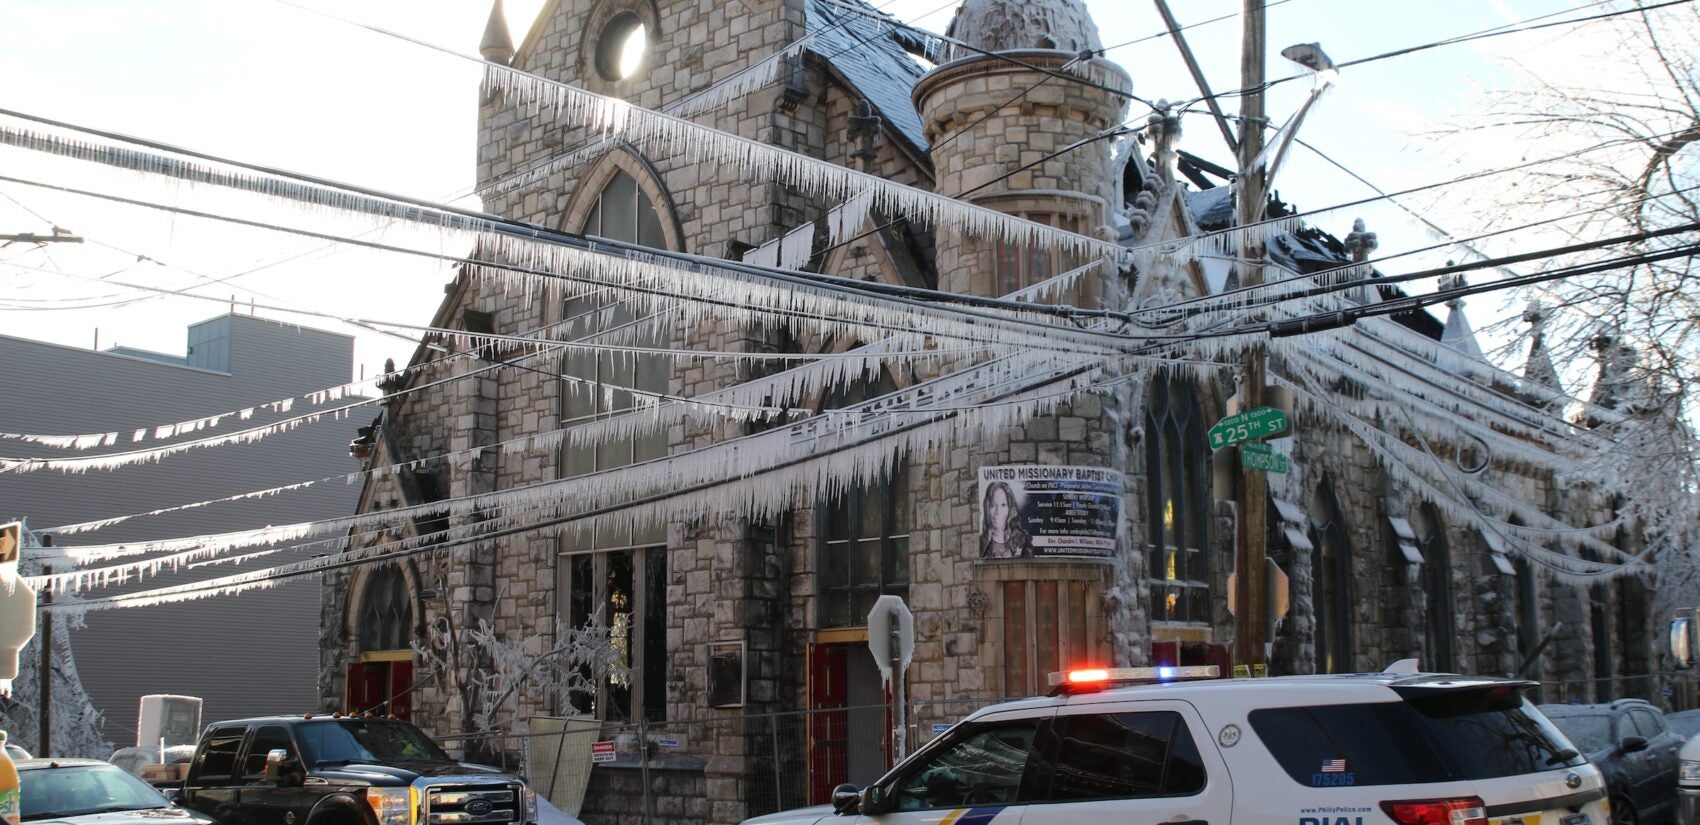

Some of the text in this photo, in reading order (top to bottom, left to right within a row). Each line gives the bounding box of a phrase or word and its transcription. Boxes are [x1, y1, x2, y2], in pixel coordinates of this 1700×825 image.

[1241, 413, 1248, 422] N
[1250, 409, 1266, 419] 1300
[1226, 418, 1283, 443] 25TH ST
[983, 468, 1016, 480] UNITED
[1018, 468, 1074, 480] MISSIONARY
[1076, 469, 1105, 482] BAPTIST
[1312, 772, 1354, 786] 175205
